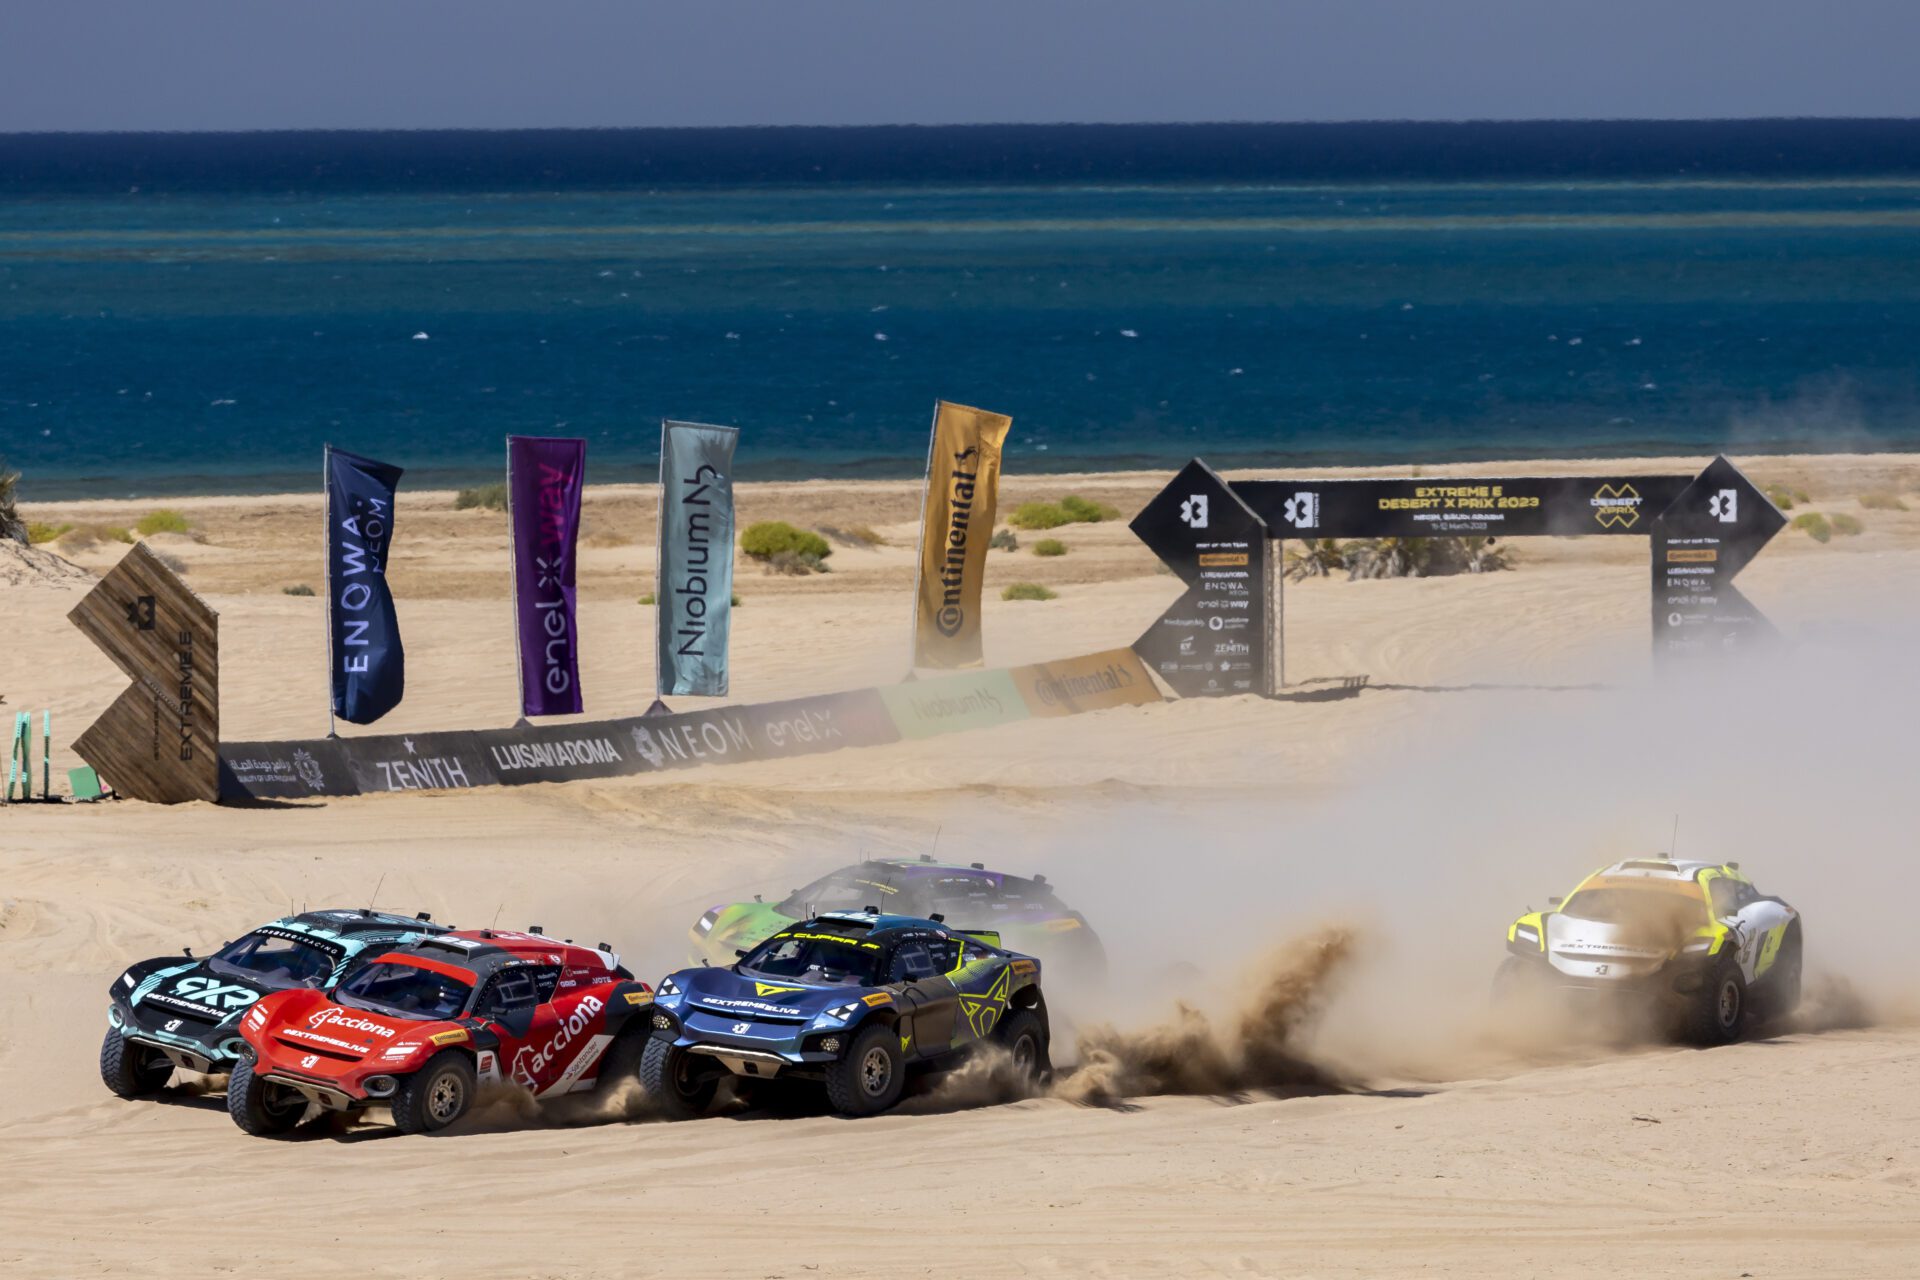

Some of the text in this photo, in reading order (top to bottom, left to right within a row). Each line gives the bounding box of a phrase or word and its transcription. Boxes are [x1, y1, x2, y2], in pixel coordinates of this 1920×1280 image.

[1378, 497, 1540, 510] DESERT X PRIX 2023
[1415, 486, 1502, 497] EXTREME E
[936, 470, 977, 638] Continental
[535, 598, 569, 694] enel
[657, 718, 752, 760] NEOM
[766, 710, 817, 746] enel
[491, 738, 622, 770] LUISAVIAROMA
[376, 756, 470, 791] ZENITH
[303, 938, 338, 955] RACING
[793, 932, 858, 946] CUPRA
[326, 1015, 396, 1038] acciona
[531, 995, 603, 1073] acciona
